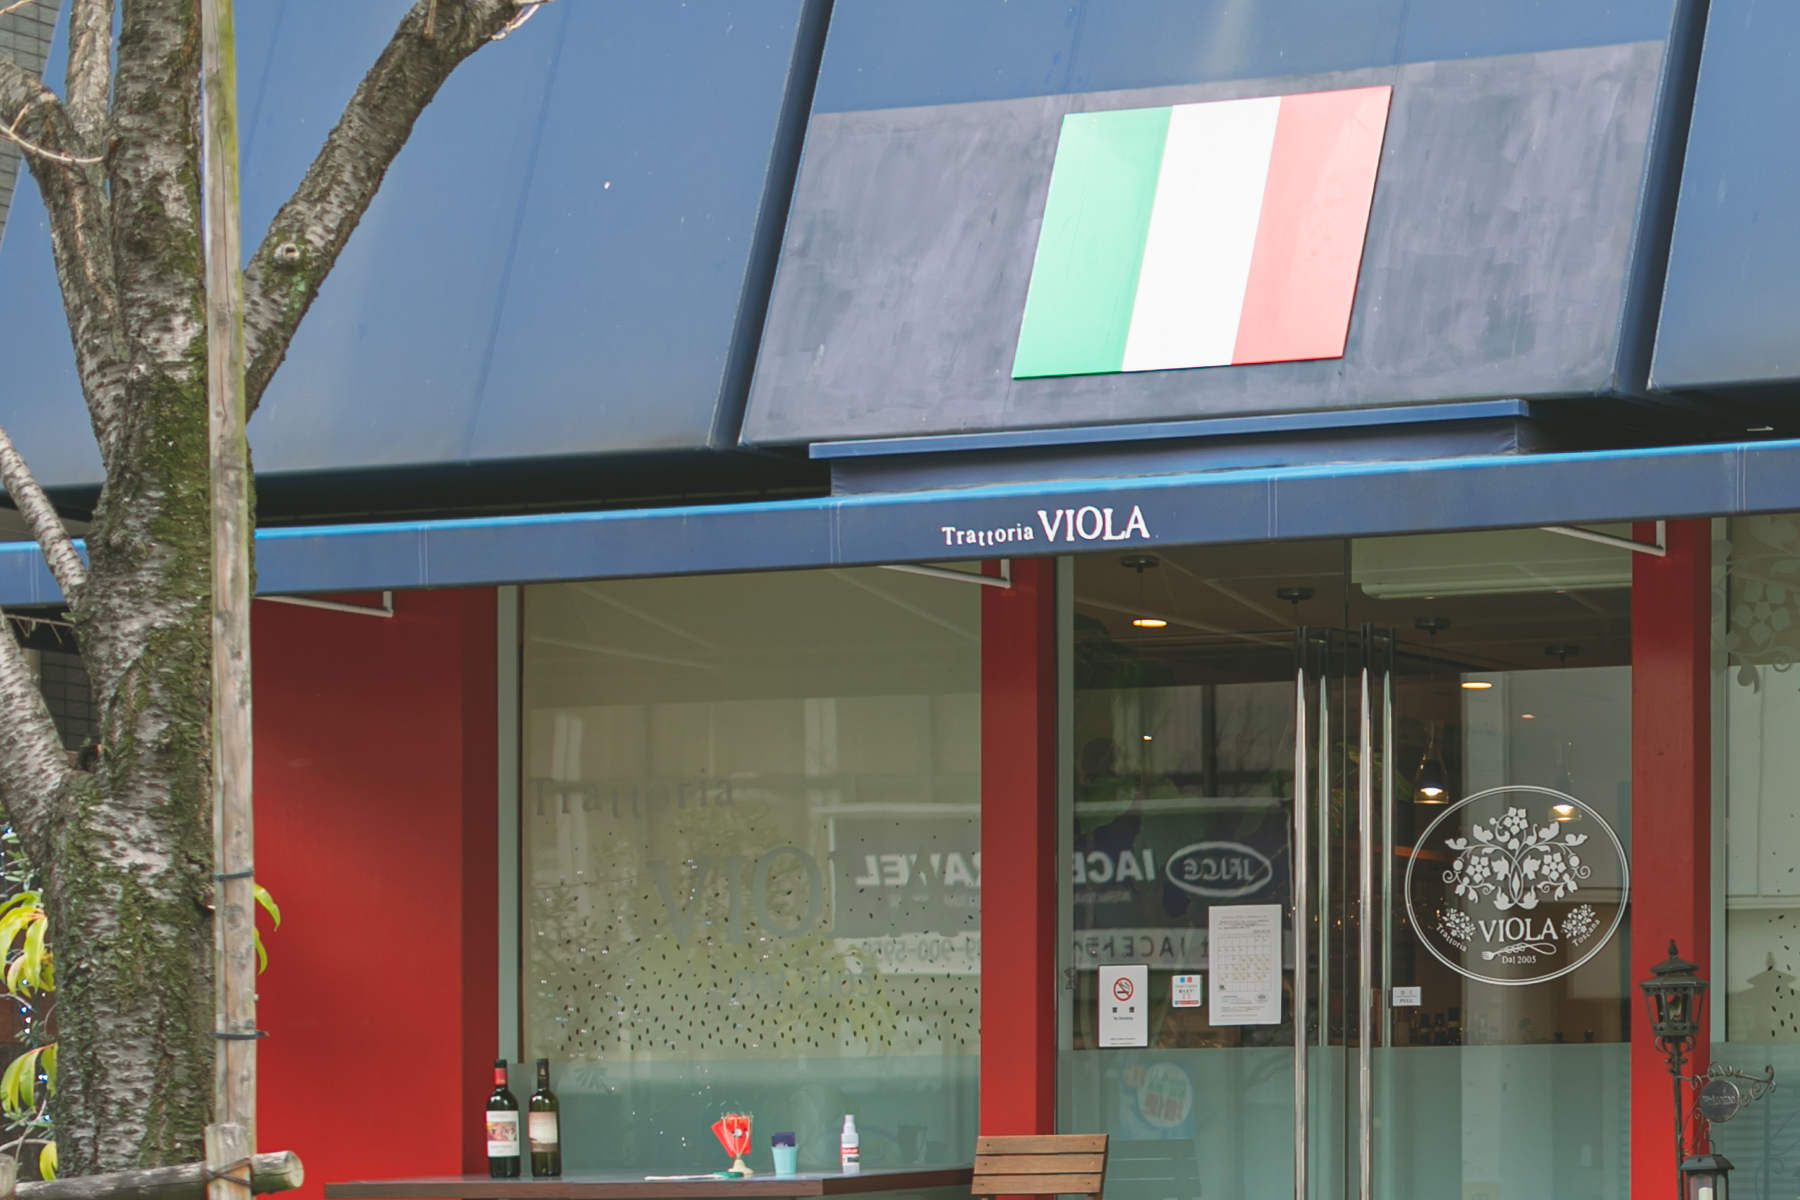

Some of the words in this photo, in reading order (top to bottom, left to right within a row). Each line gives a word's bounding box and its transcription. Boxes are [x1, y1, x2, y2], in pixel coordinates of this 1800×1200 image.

[941, 523, 1034, 546] Trattoria
[1037, 505, 1150, 542] VIOLA
[526, 768, 735, 819] Trattoria
[647, 845, 958, 945] VIOLA
[1436, 922, 1468, 953] Trattoria
[1478, 917, 1558, 942] VIOLA
[1571, 919, 1602, 948] Toscana
[1501, 955, 1516, 965] Dal
[1517, 955, 1537, 964] 2005
